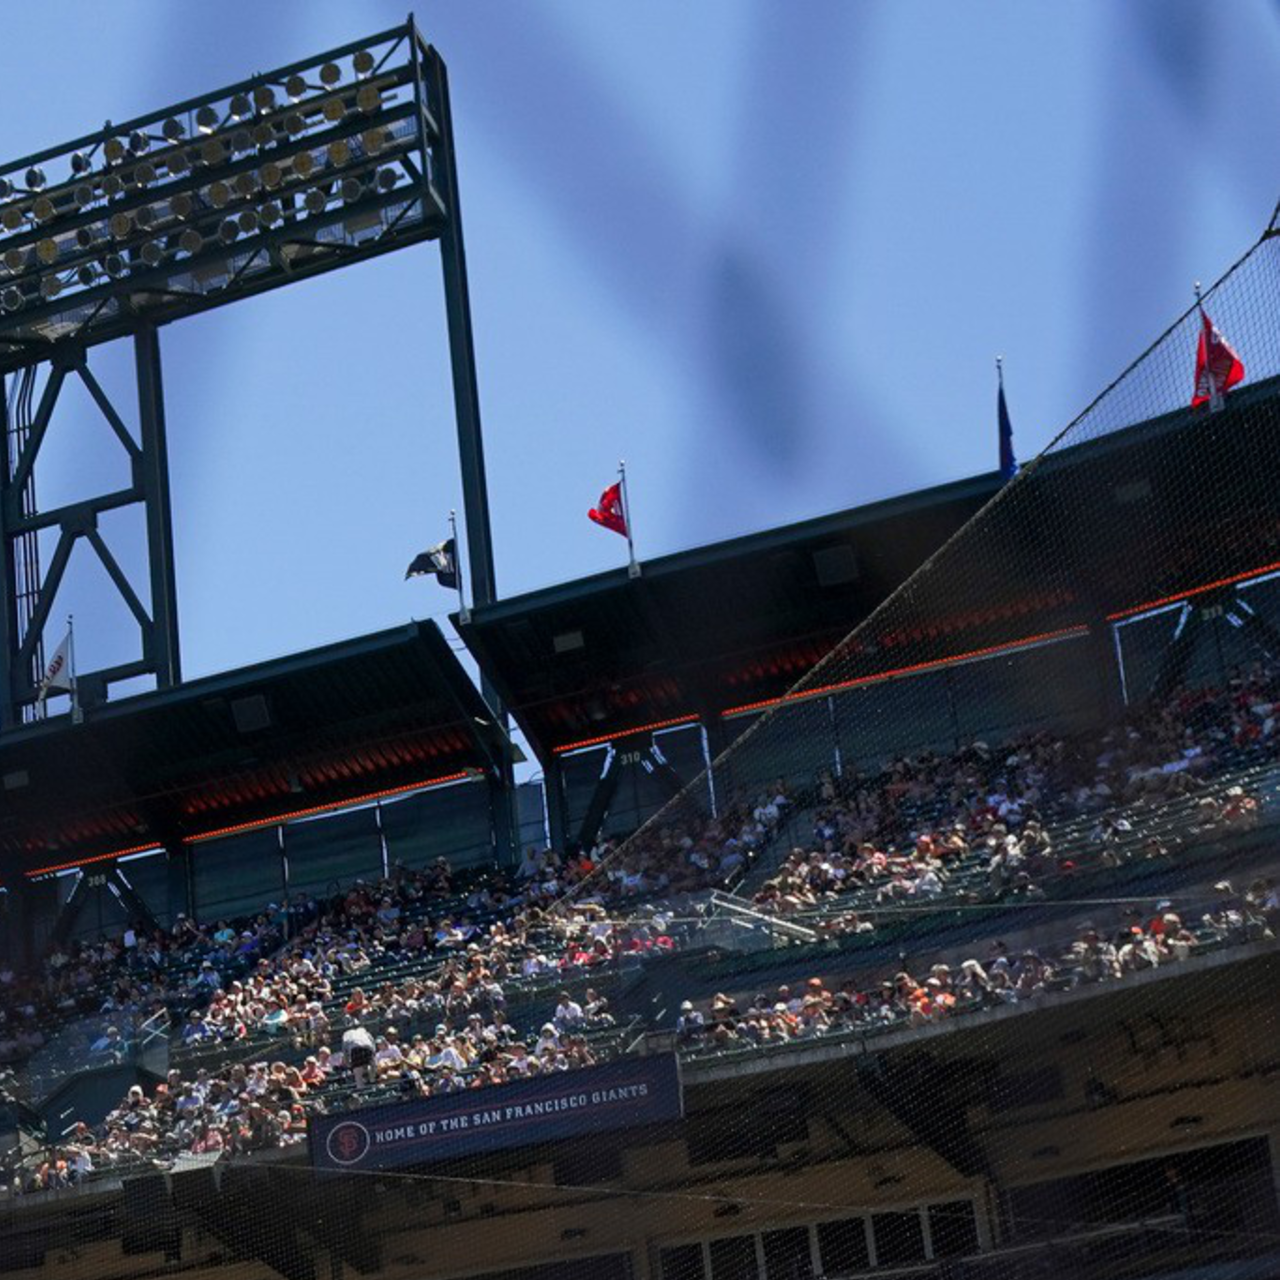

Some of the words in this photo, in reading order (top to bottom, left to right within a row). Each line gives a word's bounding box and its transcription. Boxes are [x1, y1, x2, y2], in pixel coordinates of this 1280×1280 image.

[620, 750, 641, 766] 310
[375, 1126, 416, 1144] HOME
[420, 1121, 438, 1136] OF
[440, 1114, 469, 1132] THE
[473, 1108, 502, 1126] SAN
[506, 1093, 588, 1121] FRANCISCO
[592, 1083, 649, 1106] GIANTS
